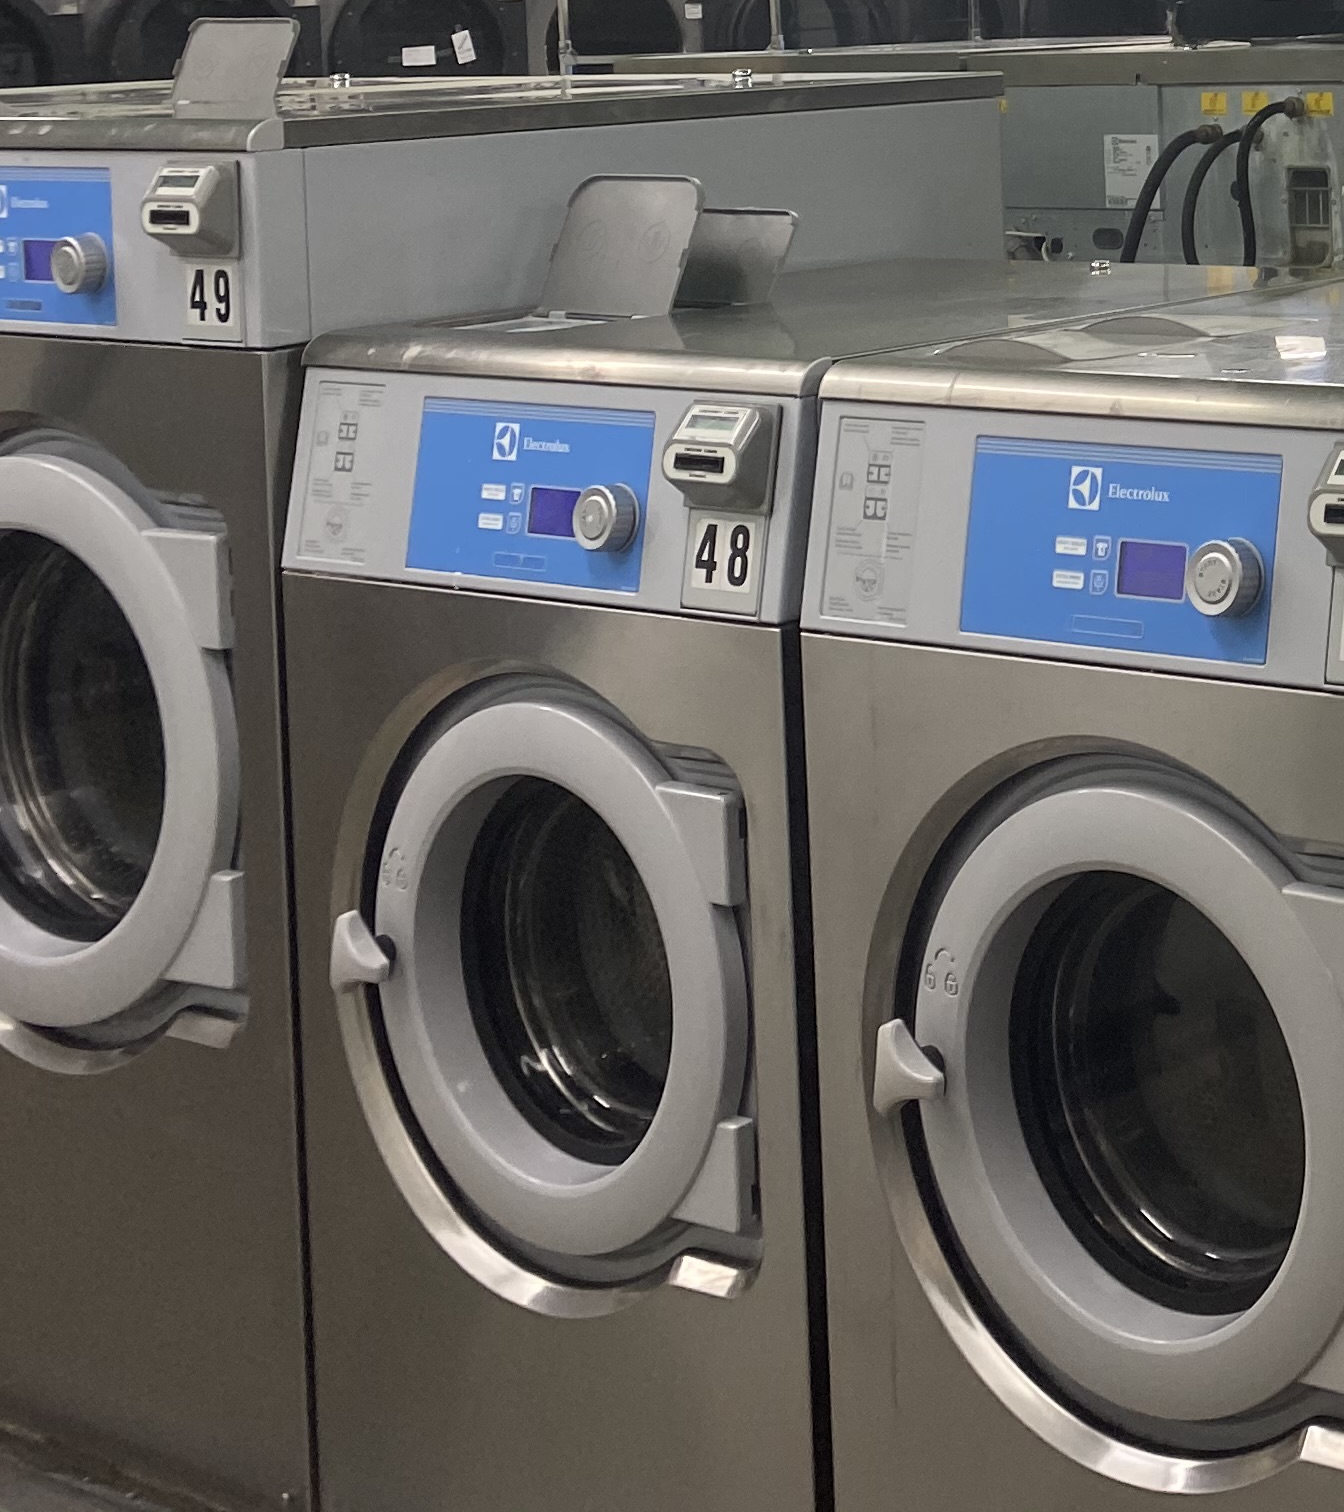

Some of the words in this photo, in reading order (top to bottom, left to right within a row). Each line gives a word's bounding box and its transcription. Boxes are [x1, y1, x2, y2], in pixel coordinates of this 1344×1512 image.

[190, 268, 231, 323] 49
[1108, 483, 1170, 503] Electrolux
[695, 523, 750, 587] 48
